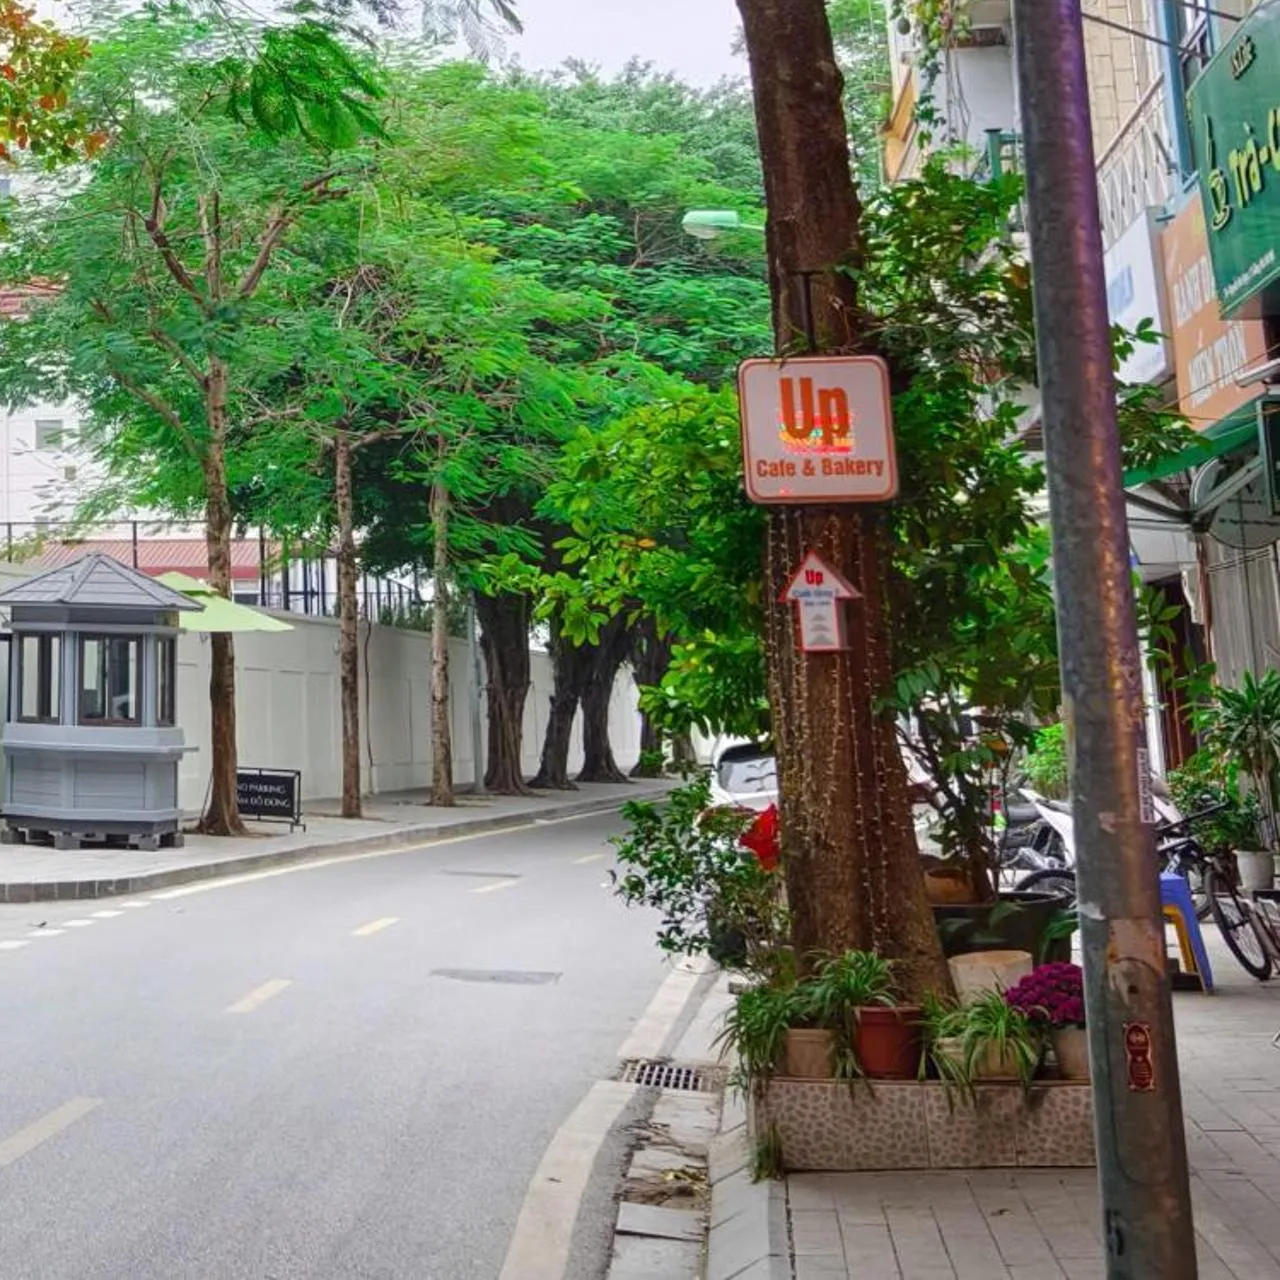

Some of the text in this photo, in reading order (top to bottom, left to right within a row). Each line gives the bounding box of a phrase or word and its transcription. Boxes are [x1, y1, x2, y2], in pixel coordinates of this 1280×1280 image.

[780, 377, 851, 446] Up
[801, 458, 816, 476] &
[821, 458, 884, 477] Bakery
[805, 569, 824, 588] Up
